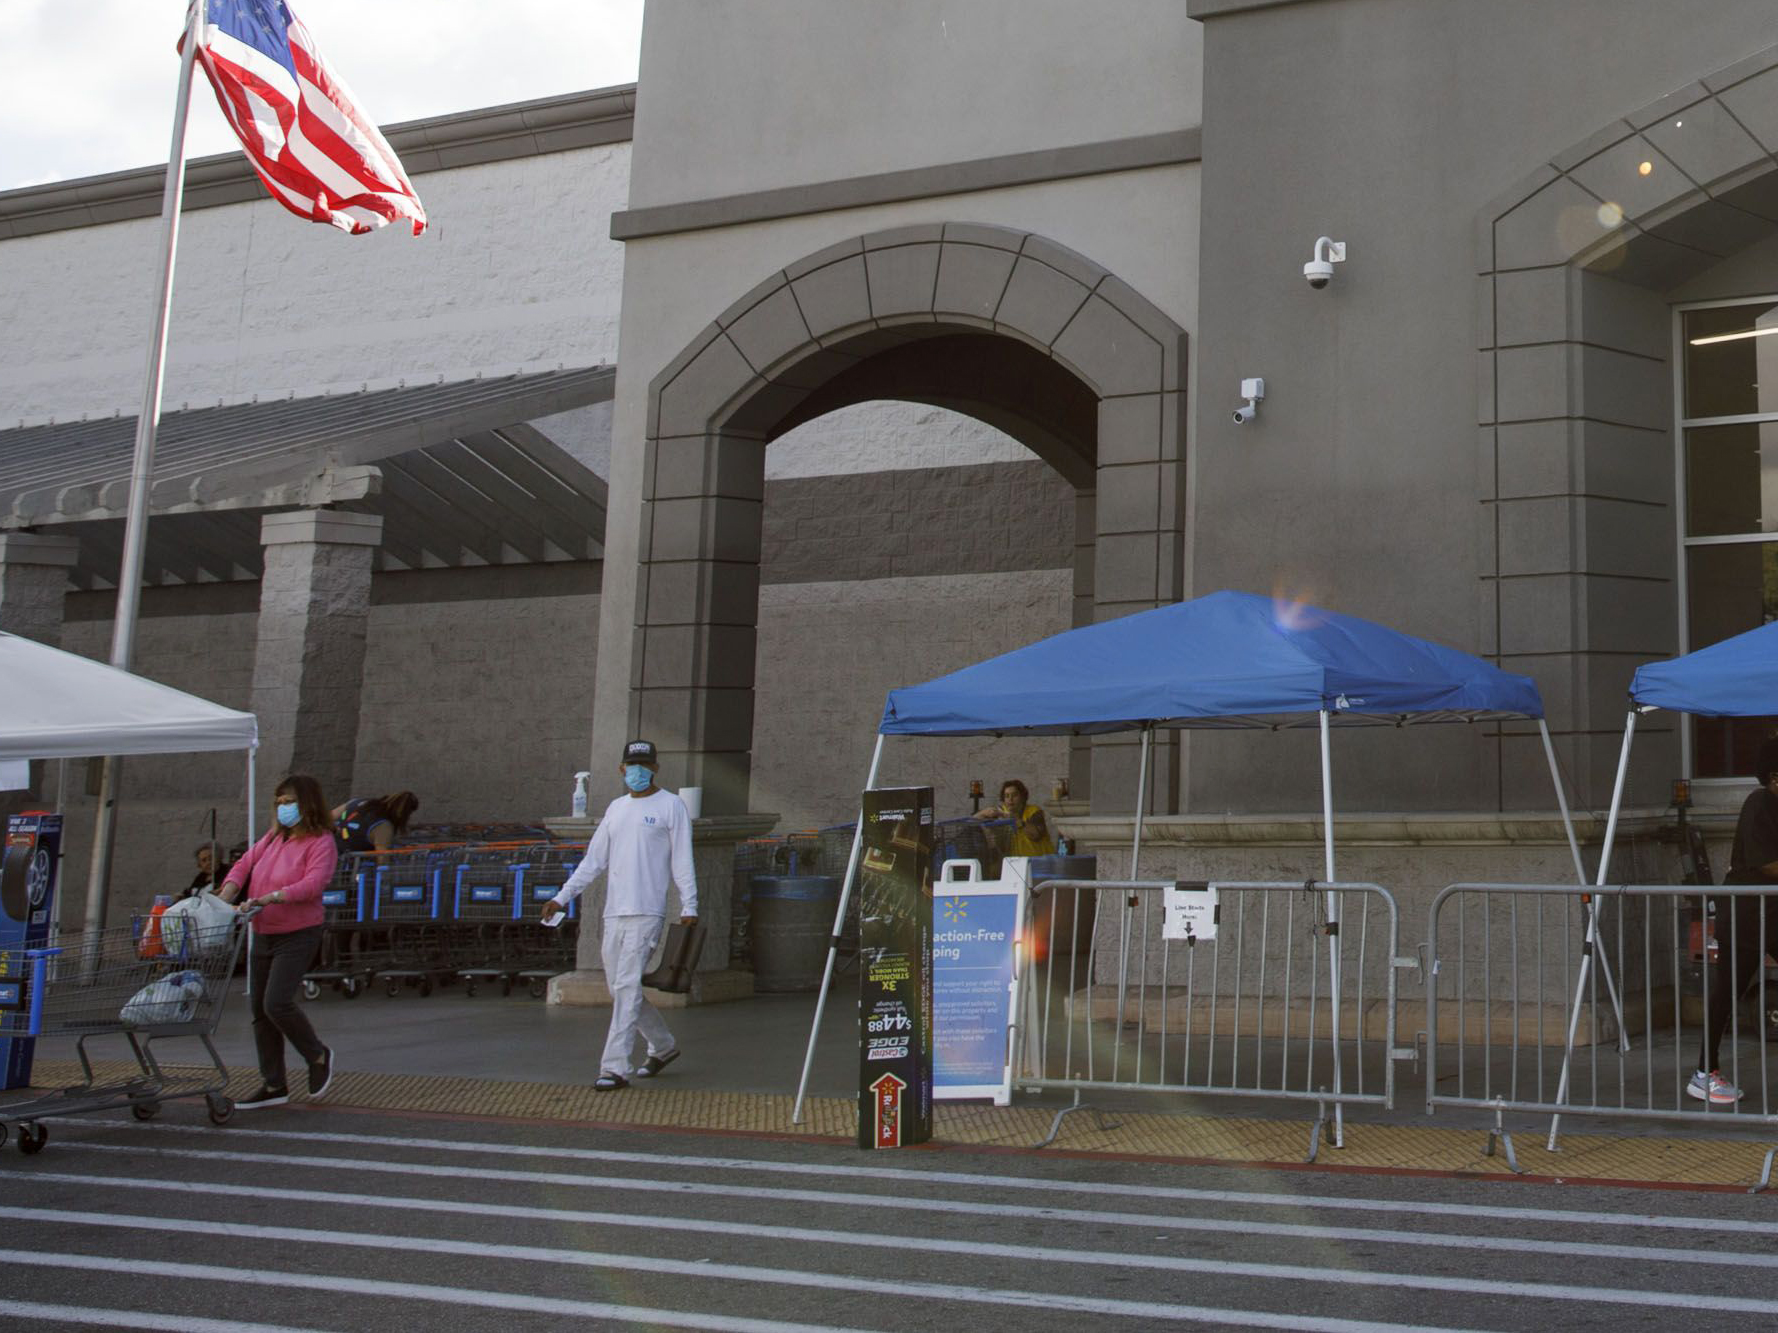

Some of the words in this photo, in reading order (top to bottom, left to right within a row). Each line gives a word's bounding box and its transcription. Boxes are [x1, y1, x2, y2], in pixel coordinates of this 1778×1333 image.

[869, 972, 910, 981] STRONGER
[867, 1036, 910, 1048] EDGE
[871, 1048, 899, 1057] Castrol
